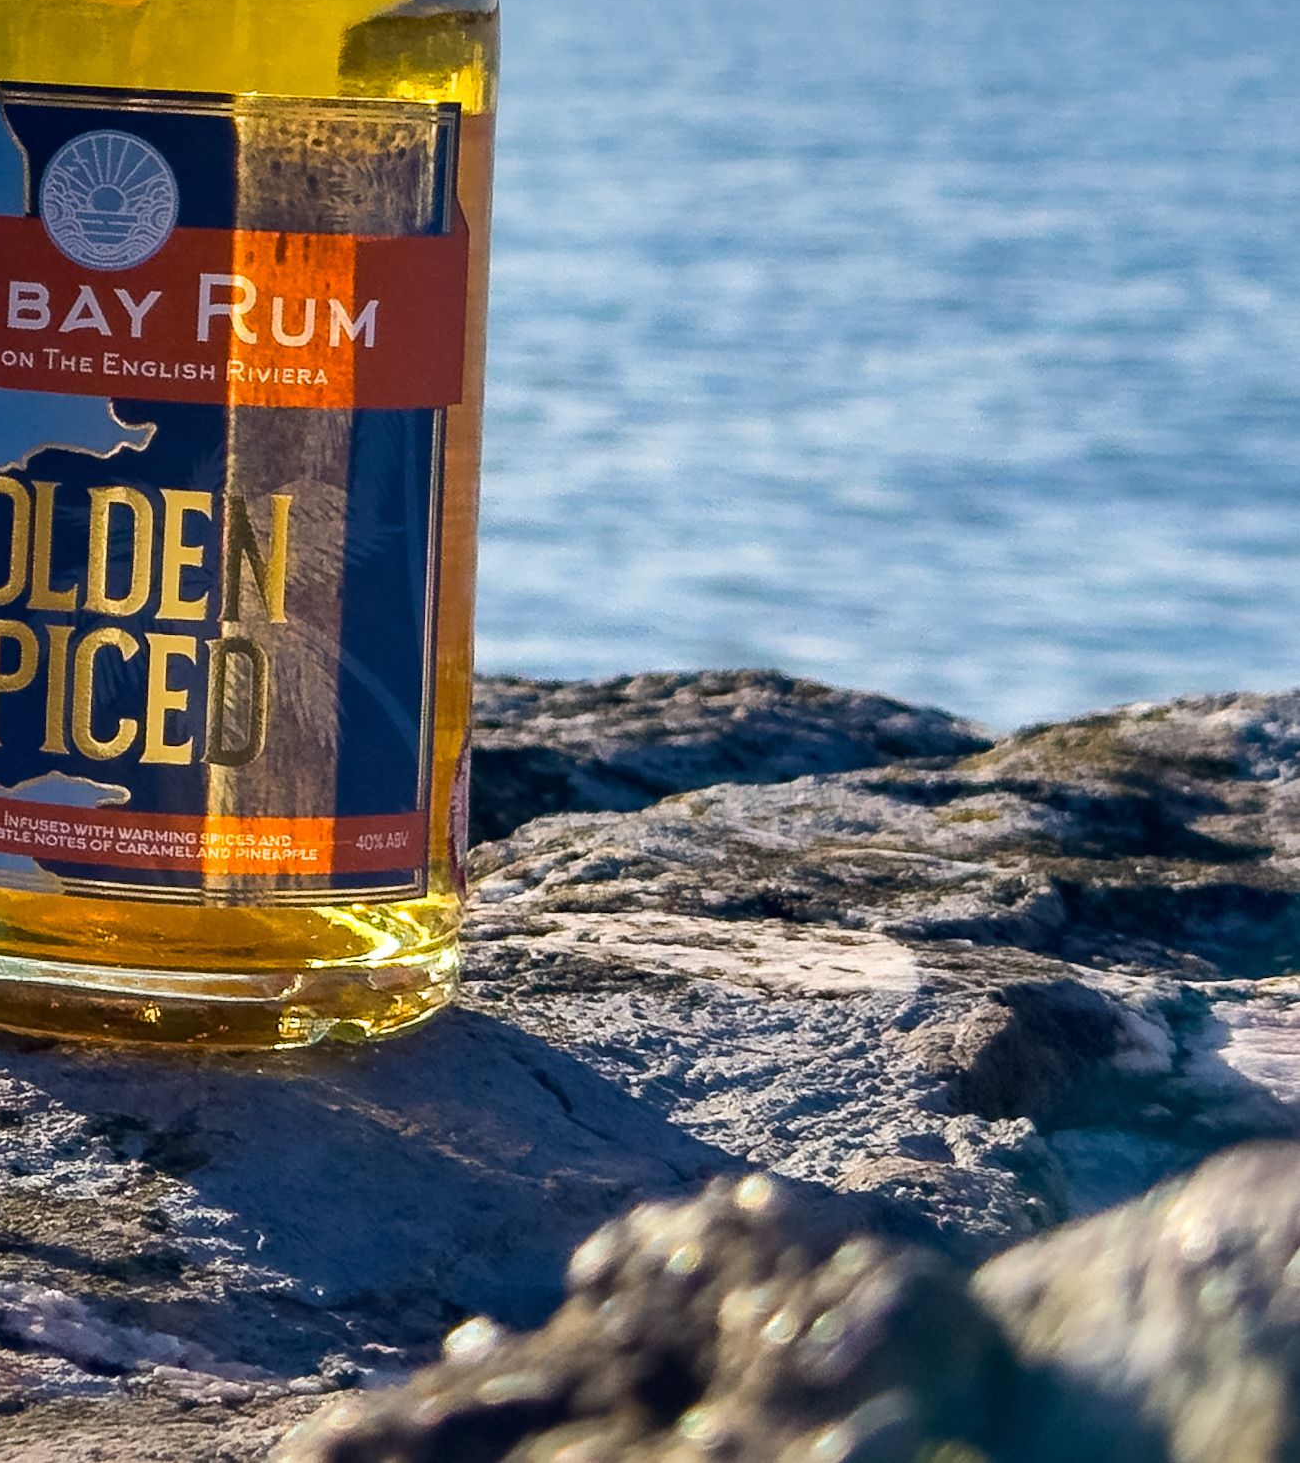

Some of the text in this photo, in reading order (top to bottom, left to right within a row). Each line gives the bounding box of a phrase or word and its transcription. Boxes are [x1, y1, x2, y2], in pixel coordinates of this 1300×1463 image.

[196, 273, 379, 349] RUM
[1, 350, 34, 368] ON
[42, 348, 93, 373] THE
[103, 352, 215, 381] ENGLISH
[226, 359, 329, 385] RIVIERA
[4, 810, 291, 847] INFUSED WITH WARMING SPICES AND
[34, 833, 86, 850] NOTES
[89, 839, 112, 852] OF
[115, 841, 196, 859] CARAMEL
[196, 846, 230, 860] AND
[235, 847, 317, 861] PINEAPPLE
[355, 833, 384, 851] 40%
